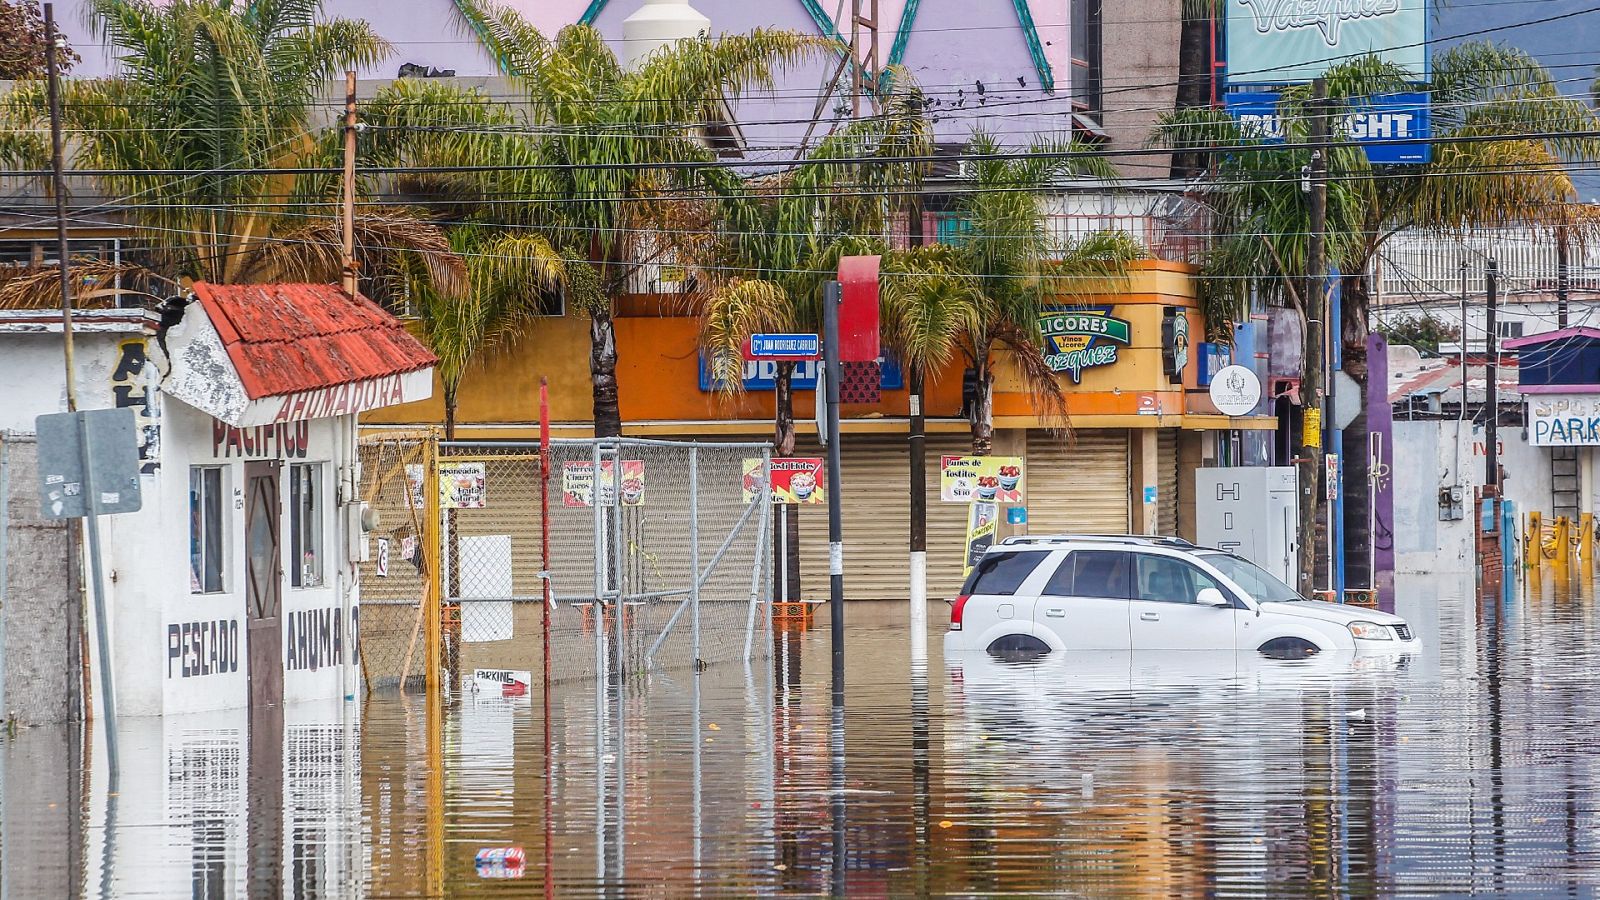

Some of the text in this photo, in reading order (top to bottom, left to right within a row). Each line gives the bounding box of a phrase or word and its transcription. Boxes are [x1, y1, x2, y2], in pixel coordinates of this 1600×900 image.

[774, 339, 797, 350] RODRIGUEZ
[1043, 345, 1117, 383] azquez
[274, 373, 404, 424] AHUMADORA
[946, 469, 977, 478] Tostitos
[972, 459, 982, 467] de
[168, 619, 238, 679] PESCADO
[287, 605, 359, 673] AHUMAO
[477, 671, 515, 684] PARKING
